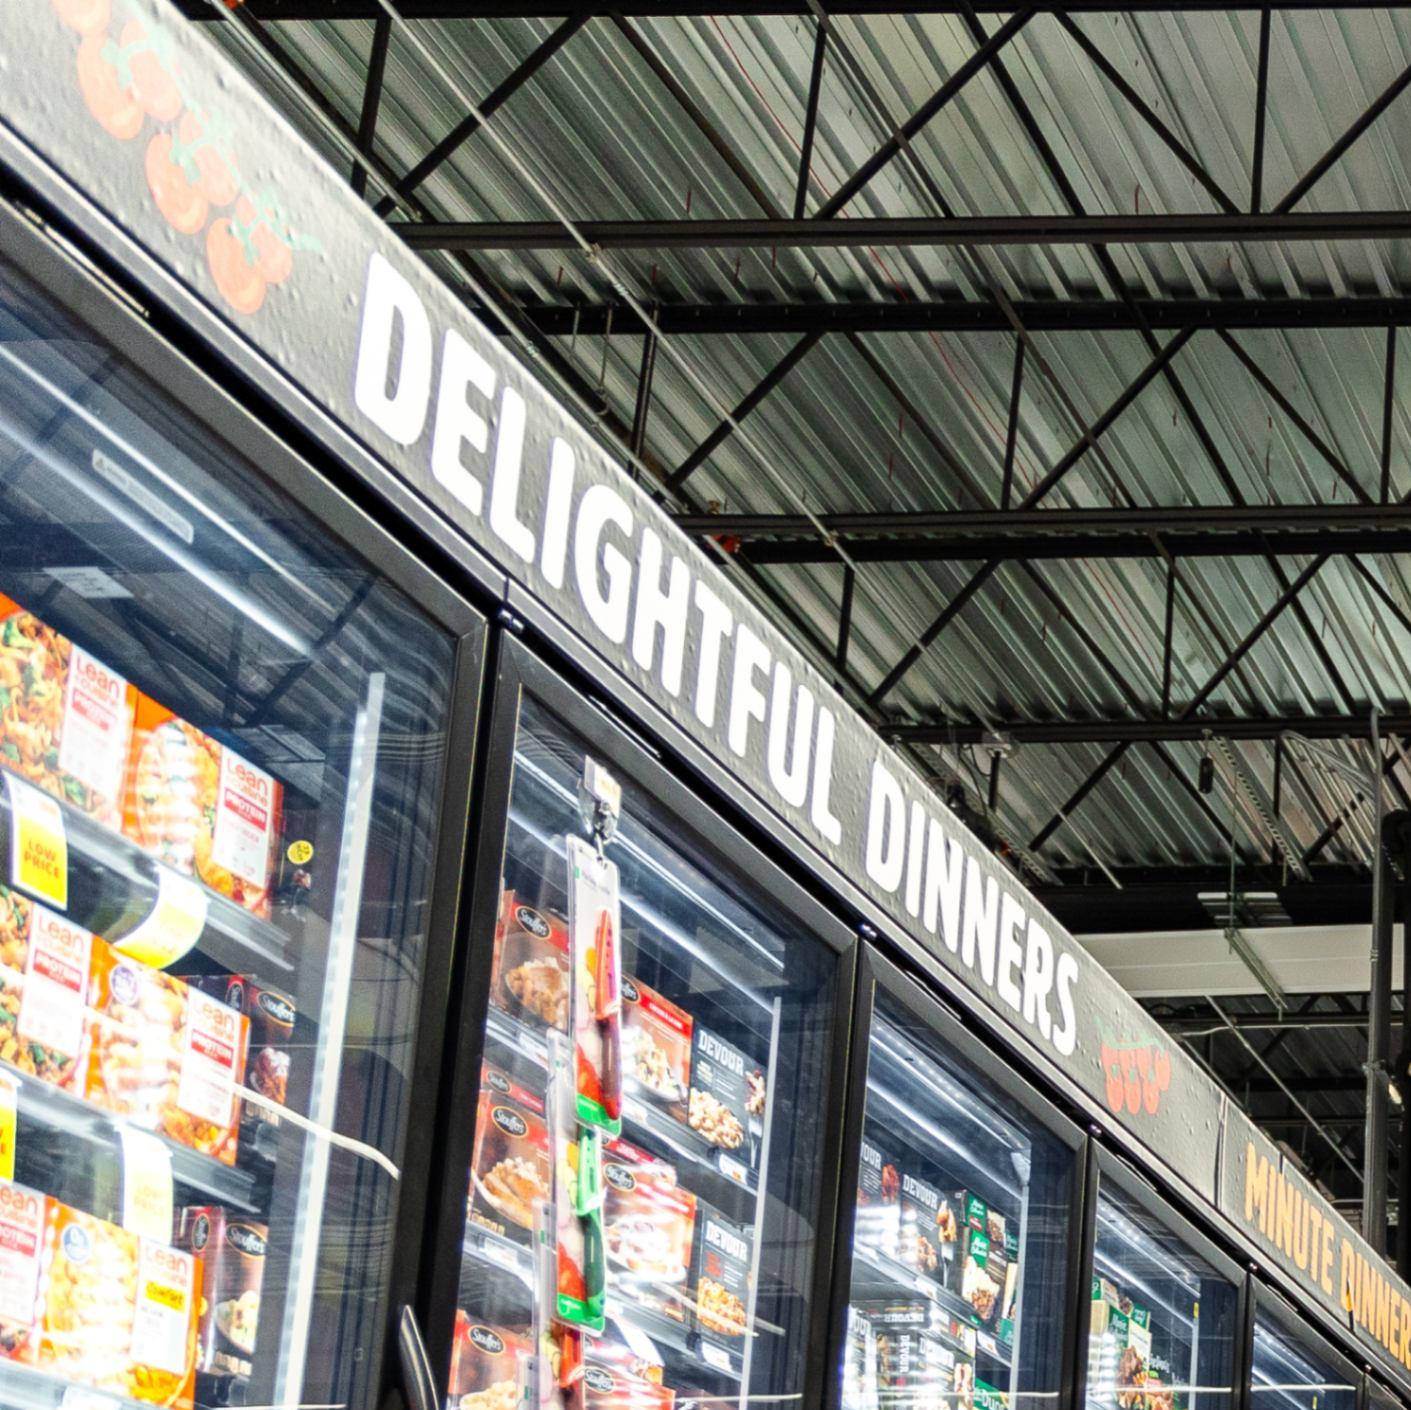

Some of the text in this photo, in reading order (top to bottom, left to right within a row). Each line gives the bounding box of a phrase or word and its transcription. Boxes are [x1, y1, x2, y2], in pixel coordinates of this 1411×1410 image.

[351, 248, 1081, 1058] DELIGHTFUL DINNERS
[75, 652, 120, 699] Lean
[226, 756, 270, 795] Lean
[226, 792, 266, 823] PROTEIN
[24, 854, 60, 879] PRICE
[28, 839, 57, 862] LOW
[38, 917, 85, 949] Lean
[698, 1030, 746, 1076] DEVOUR
[0, 1185, 37, 1216] ean
[902, 1173, 939, 1209] DEVOUR
[1244, 1141, 1335, 1296] MINUTE
[899, 1335, 911, 1374] DEVOUR
